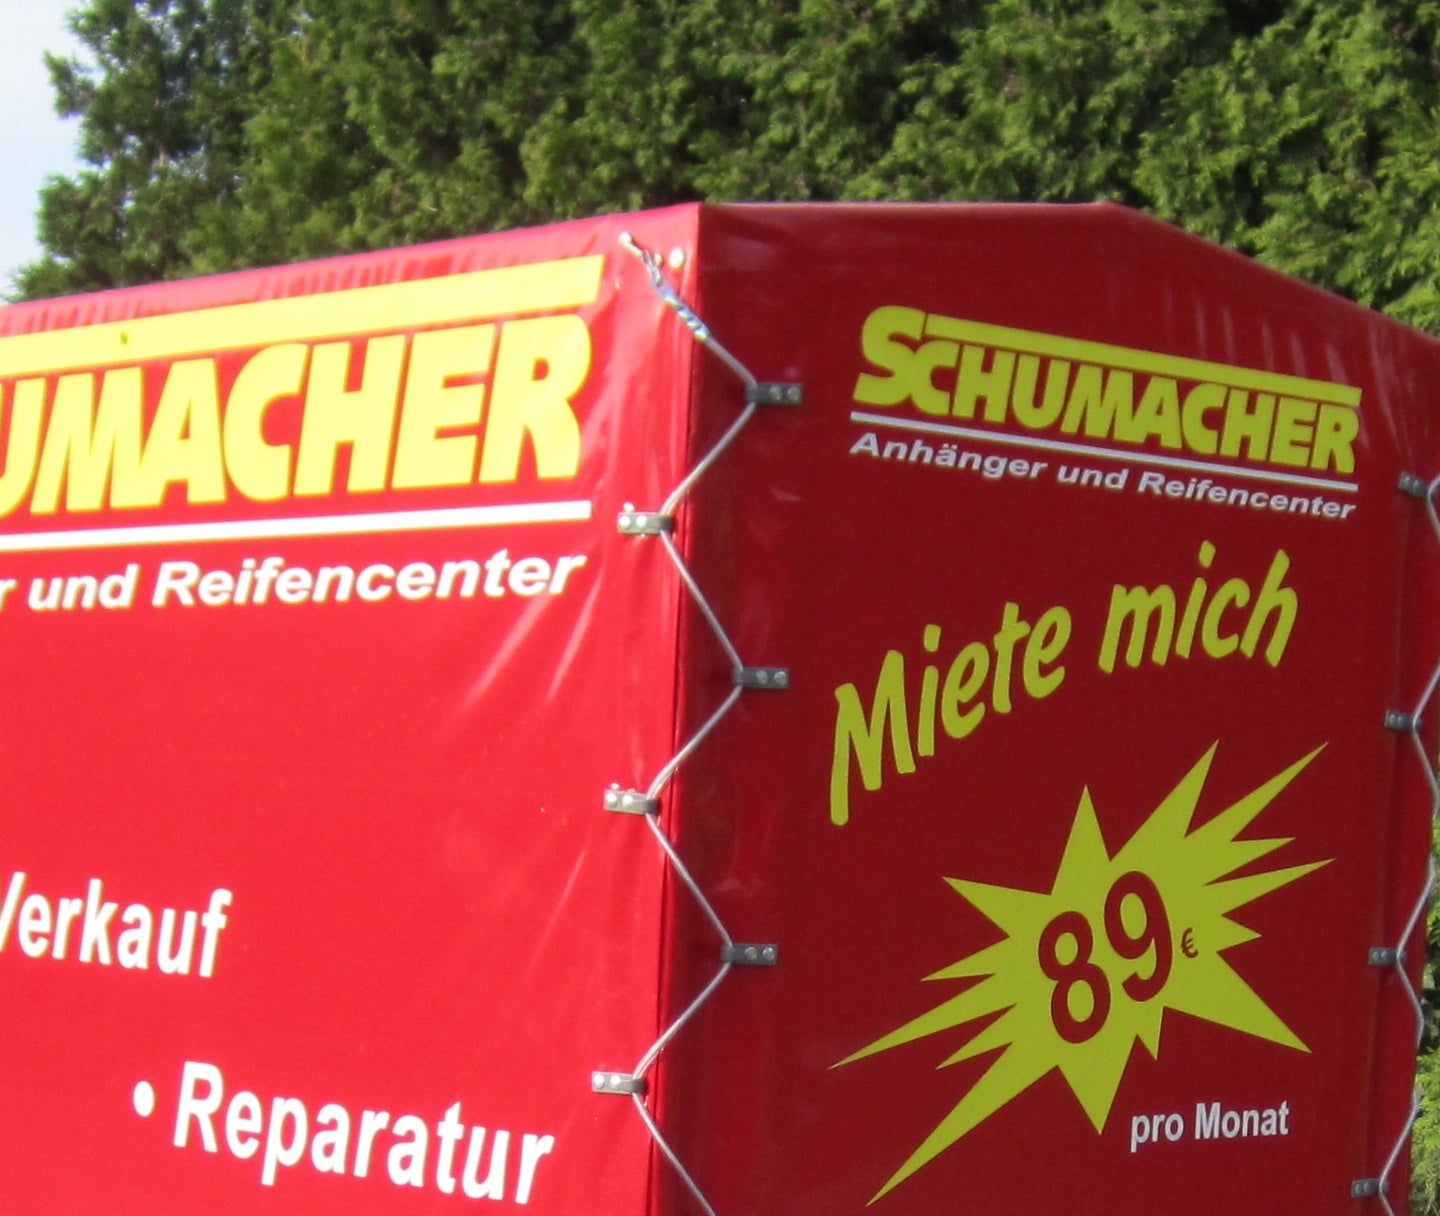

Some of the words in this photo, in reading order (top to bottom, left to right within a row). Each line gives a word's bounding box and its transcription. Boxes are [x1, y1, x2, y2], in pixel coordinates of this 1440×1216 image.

[852, 305, 1361, 475] SCHUMACHER
[849, 431, 1048, 482] Anhänger
[1057, 461, 1128, 491] und
[1136, 471, 1356, 520] Reifencenter
[27, 564, 138, 610] und
[152, 547, 588, 608] Reifencenter
[830, 601, 1072, 826] Miete
[1098, 540, 1299, 675] mich
[1037, 869, 1173, 1044] 89
[1180, 927, 1199, 960] €
[172, 1060, 555, 1205] Reparatur
[1130, 1105, 1184, 1153] pro
[1195, 1101, 1290, 1140] Monat
